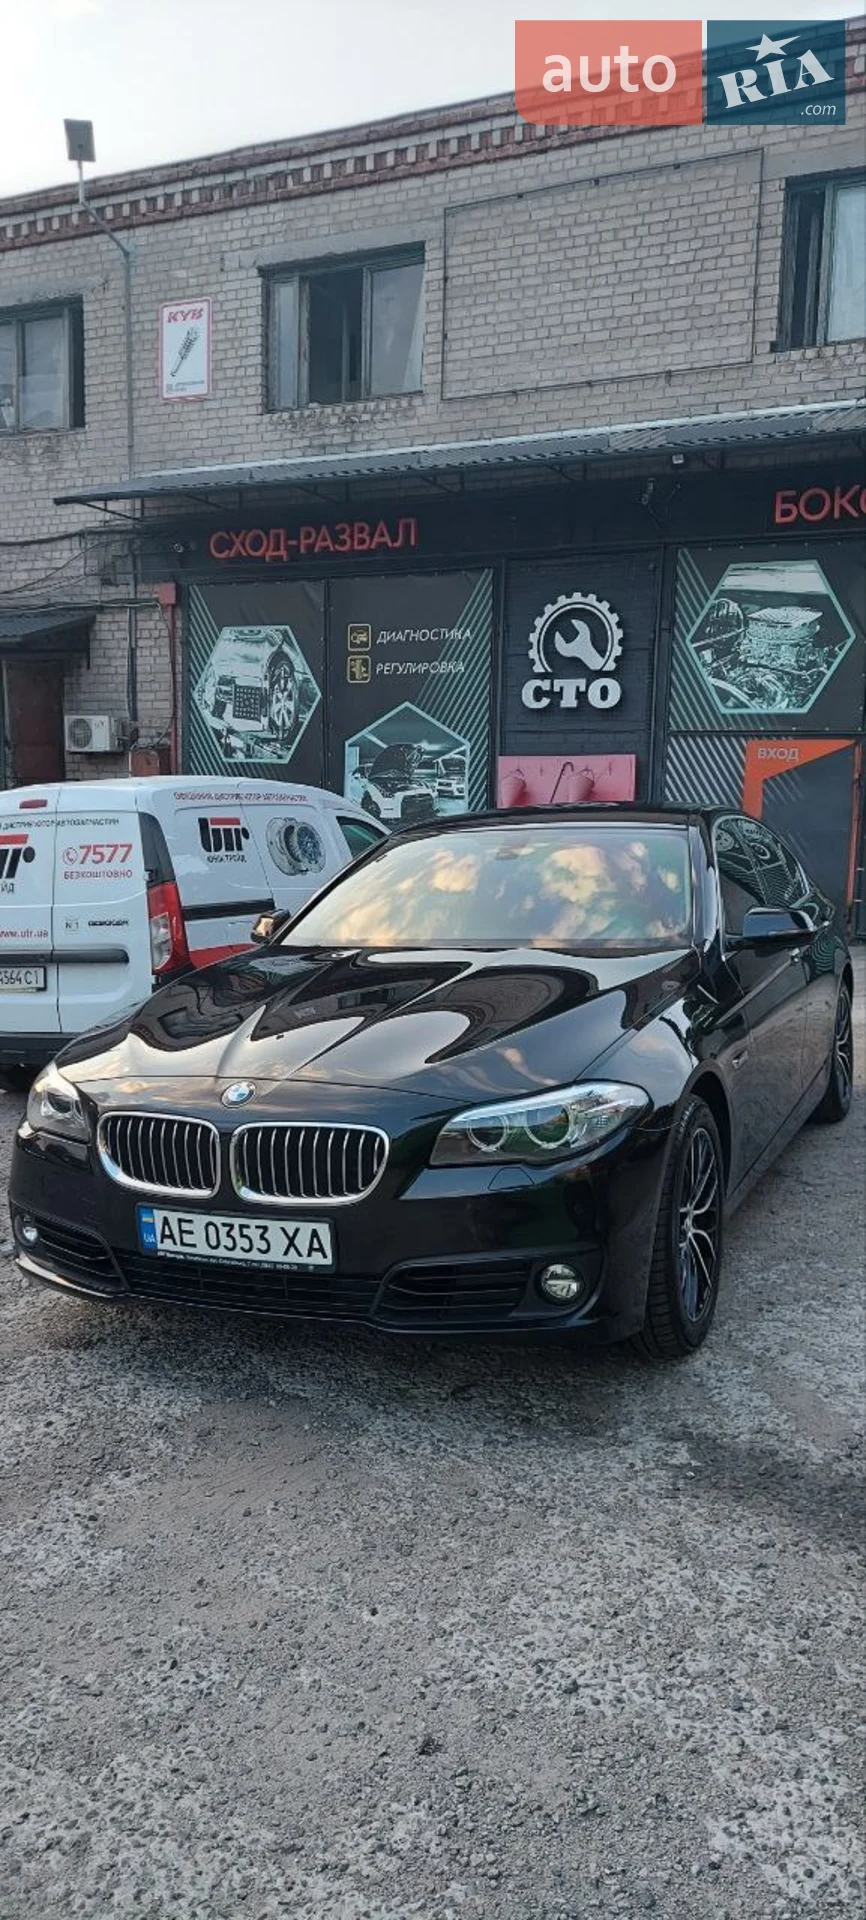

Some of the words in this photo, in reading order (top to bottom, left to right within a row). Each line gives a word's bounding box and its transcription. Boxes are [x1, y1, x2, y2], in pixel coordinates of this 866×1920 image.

[775, 484, 866, 523] БОК
[210, 517, 417, 562] СХОД-РАЗВАЛ
[376, 628, 472, 645] ДИАГНОСТИКА
[376, 661, 465, 675] РЕГУЛИРОВКА
[521, 677, 622, 709] СТО
[757, 747, 800, 763] ВХОД
[79, 843, 133, 864] 7577
[64, 869, 133, 880] БЕЗКОШТОВНО
[159, 1215, 198, 1249] AE
[203, 1220, 272, 1255] 0353
[278, 1226, 329, 1259] XA
